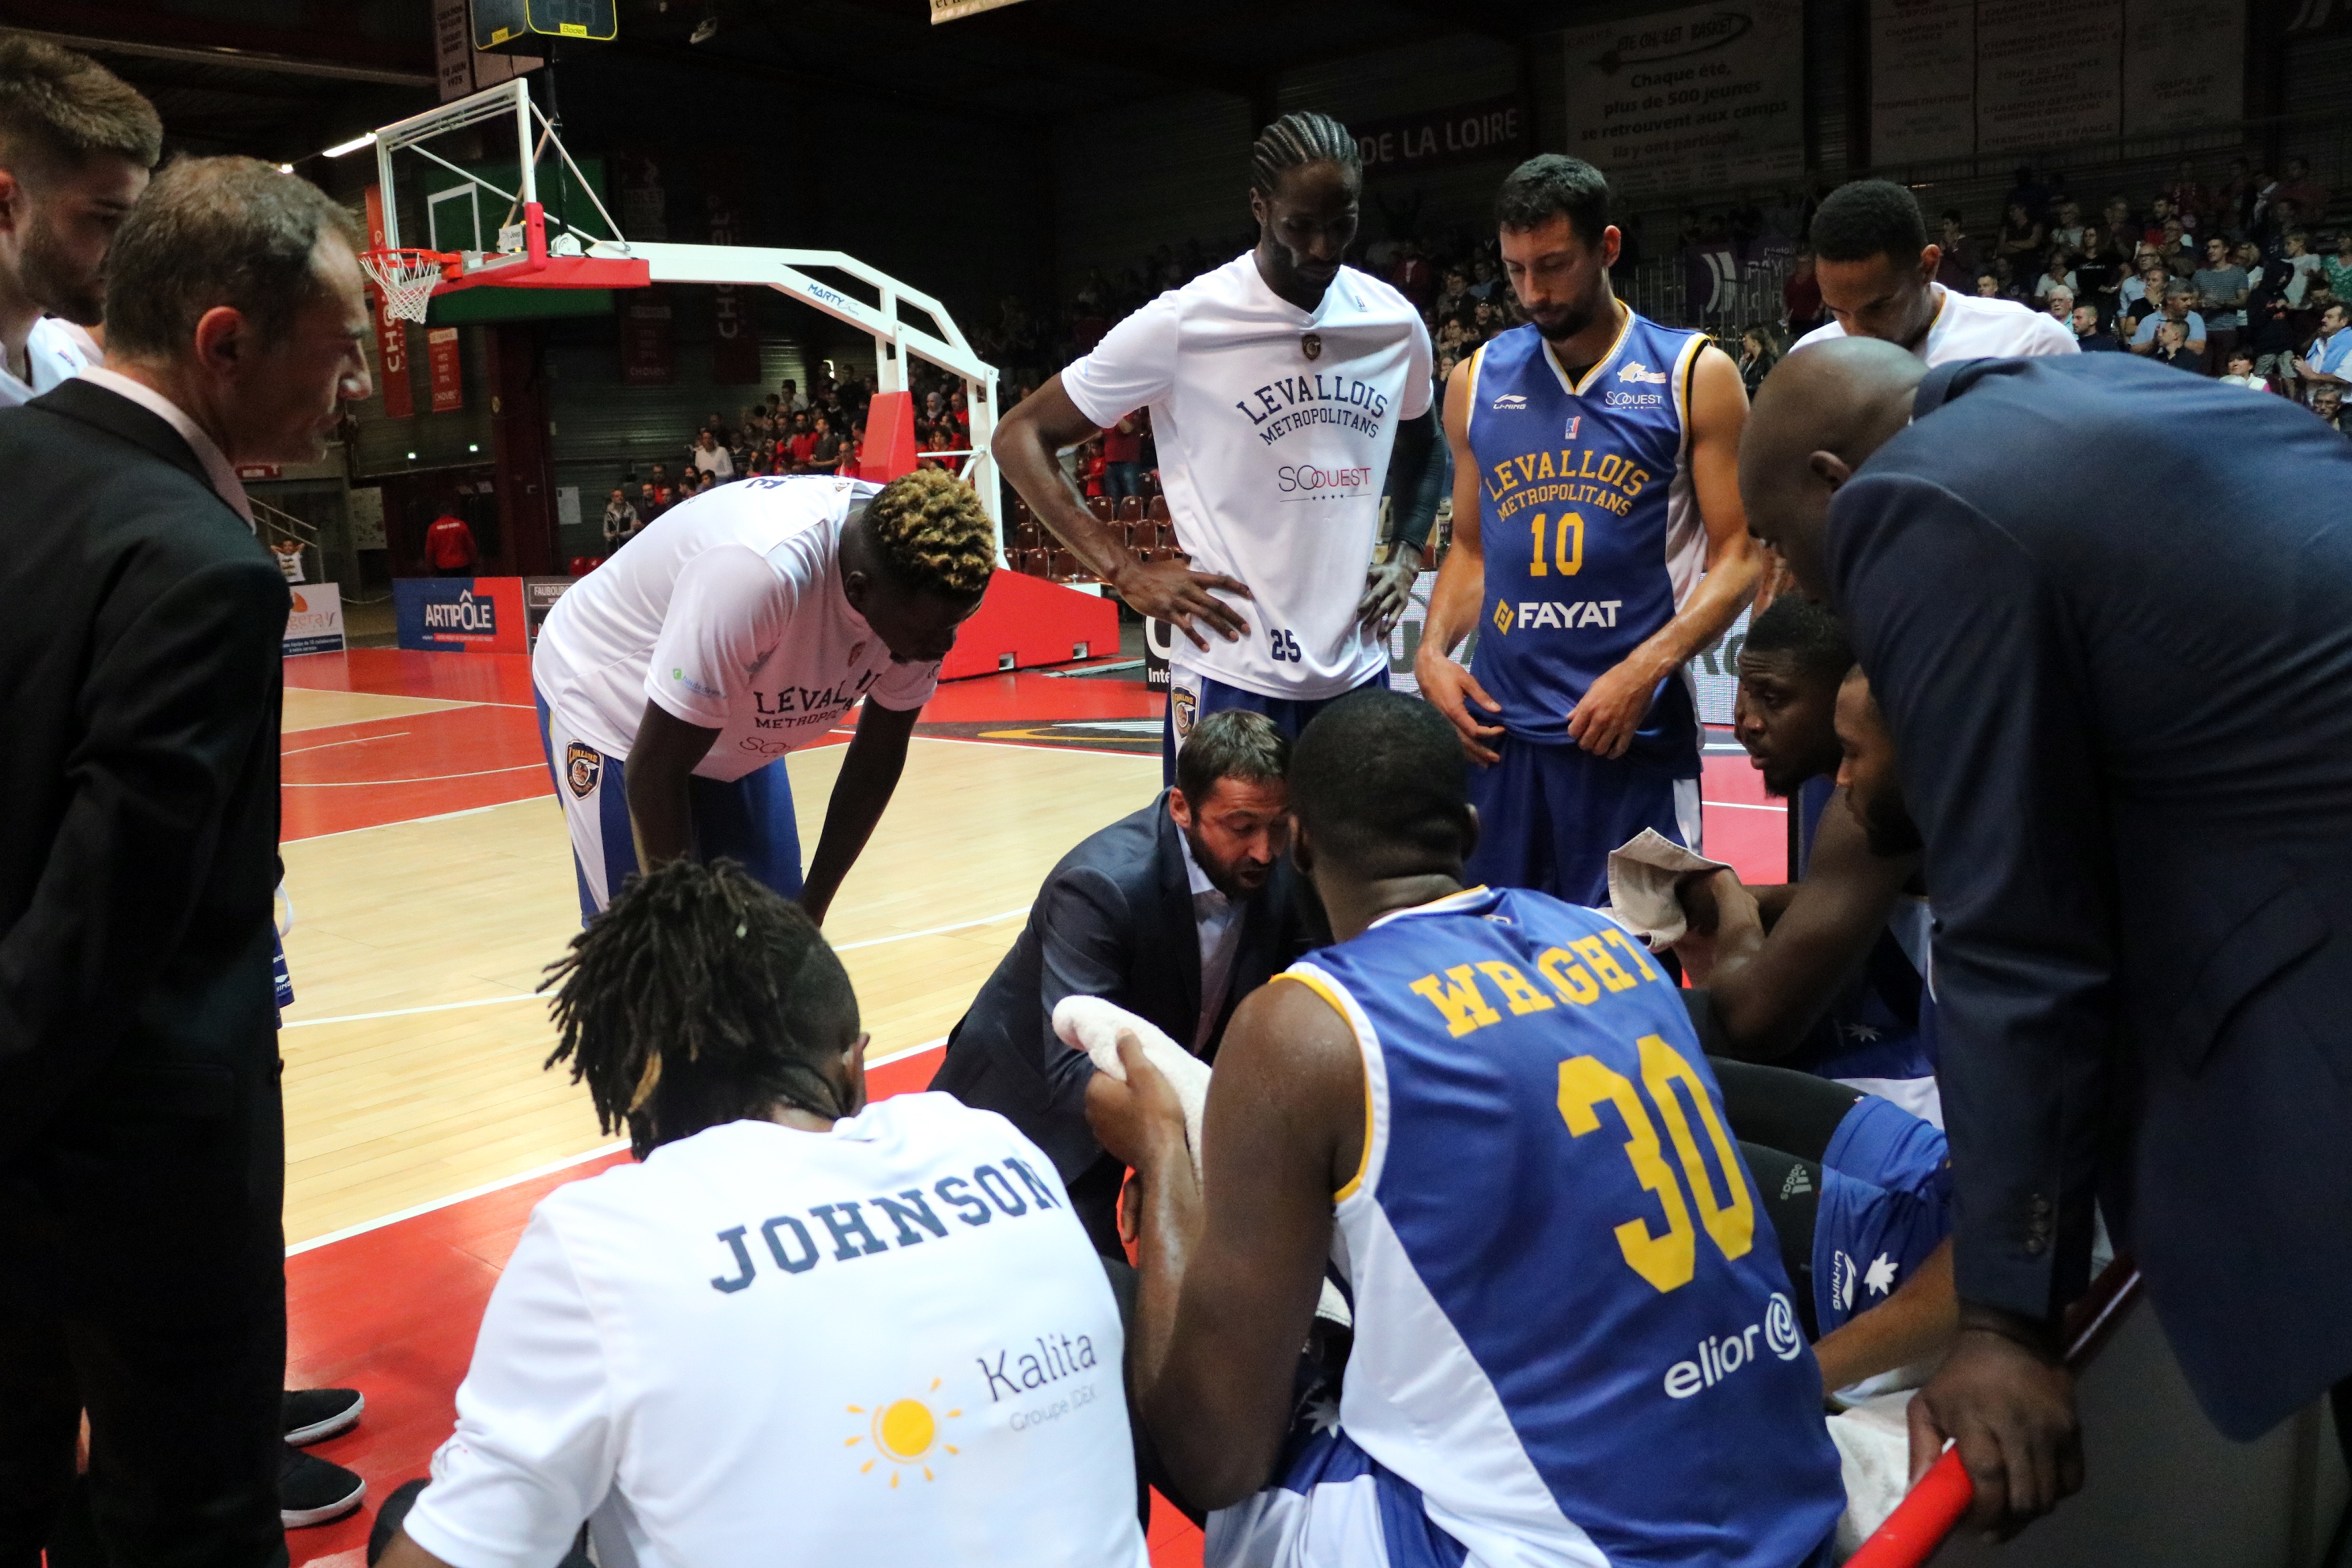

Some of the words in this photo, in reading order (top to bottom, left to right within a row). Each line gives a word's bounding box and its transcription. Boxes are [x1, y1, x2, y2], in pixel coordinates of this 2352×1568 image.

[1630, 67, 1695, 89] Chaque
[1581, 129, 1597, 141] se
[1601, 113, 1691, 138] retrouvent
[1695, 109, 1728, 125] aux
[1733, 100, 1789, 121] camps
[1604, 98, 1637, 119] plus
[1642, 94, 1663, 109] de
[1667, 88, 1699, 106] 500
[1702, 80, 1762, 104] jeunes
[1360, 131, 1394, 166] DE
[1403, 125, 1438, 158] LA
[1446, 108, 1518, 151] LOIRE
[808, 283, 845, 306] MARTY
[1237, 374, 1388, 426] LEVALLOIS
[1259, 407, 1379, 446] METROPOLITANS
[1485, 449, 1650, 501] LEVALLOIS
[1497, 484, 1633, 522] METROPOLITANS
[1530, 513, 1584, 577] 10
[425, 588, 492, 631] ARTIPÔLE
[1518, 600, 1623, 629] FAYAT
[1270, 629, 1302, 663] 25
[1148, 667, 1171, 683] Inte
[1408, 927, 1658, 1039] WRGHT
[1557, 1034, 1754, 1294] 30
[1780, 1163, 1803, 1201] adidas
[710, 1157, 1063, 1294] JOHNSON
[1832, 1250, 1844, 1311] LI-NING
[975, 1333, 1097, 1402] Kalita
[1663, 1323, 1760, 1399] elior
[1010, 1399, 1069, 1432] Groupe
